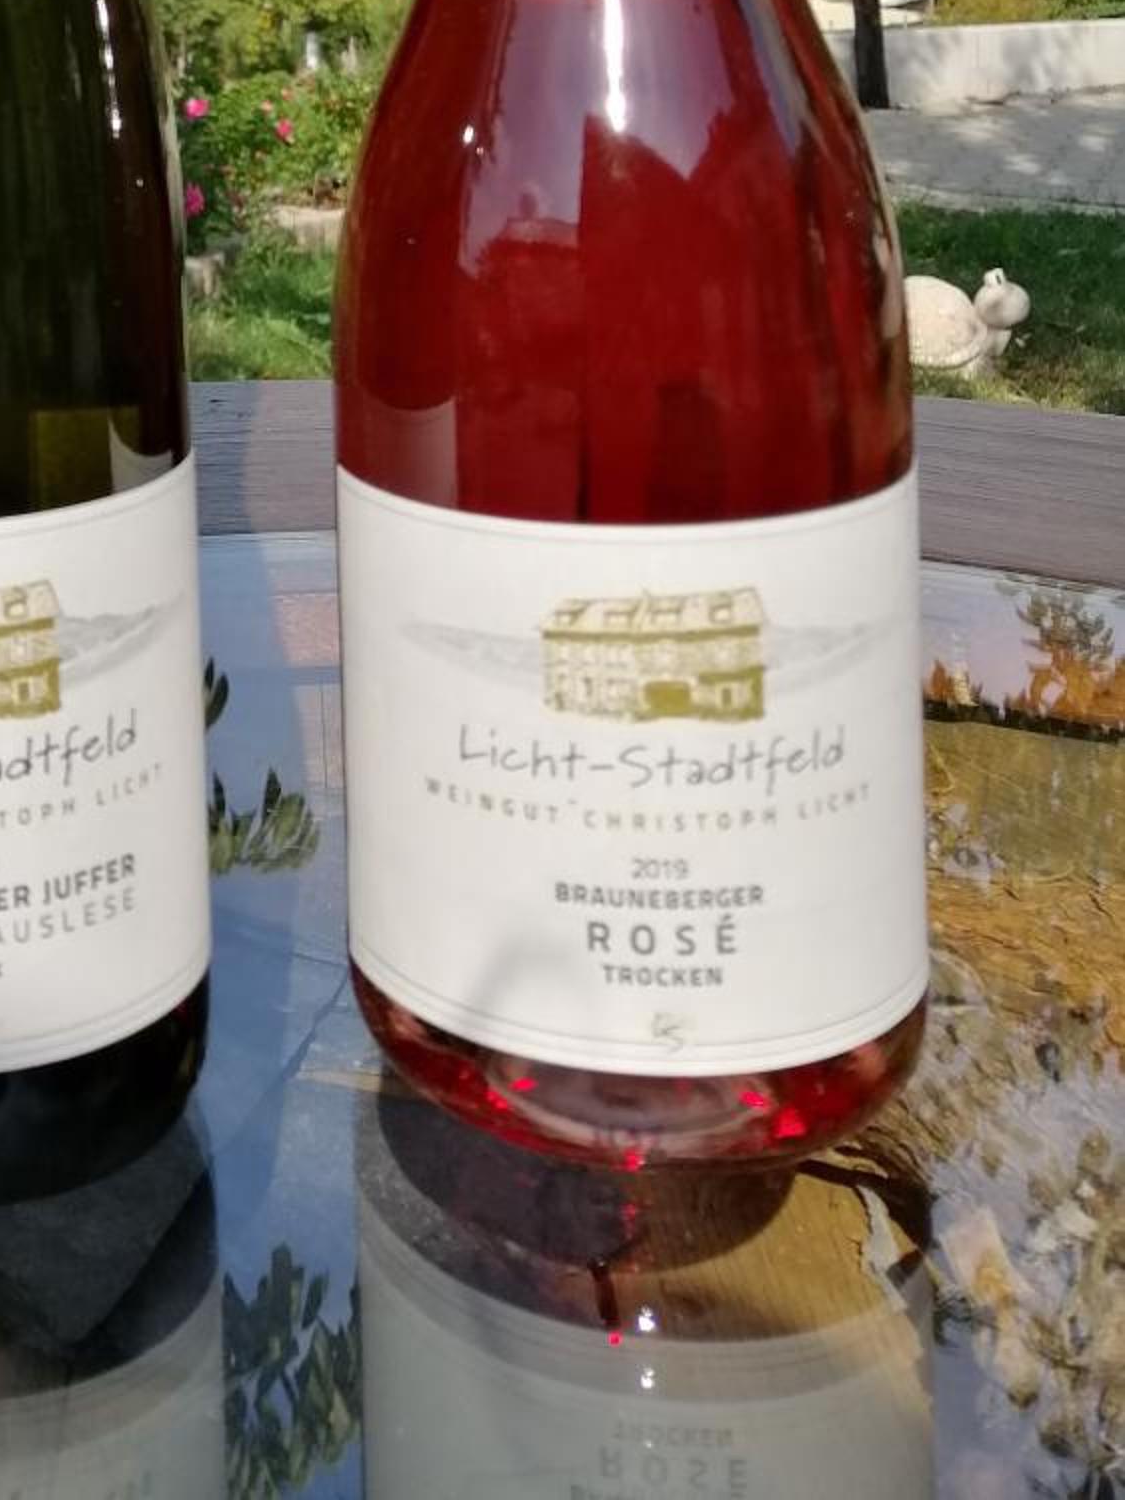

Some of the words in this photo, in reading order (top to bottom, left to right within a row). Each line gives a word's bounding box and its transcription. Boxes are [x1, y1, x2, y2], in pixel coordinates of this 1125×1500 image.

[458, 723, 846, 796] Licht-Stadtfeld
[94, 763, 163, 808] LICHT
[424, 776, 559, 824] WEINGUT
[583, 808, 776, 833] CHRISTOPH
[797, 783, 871, 821] LICHT
[42, 853, 137, 906] JUFFER
[630, 857, 690, 880] 2019
[554, 881, 764, 911] BRAUNEBERGER
[587, 914, 739, 957] ROSÉ
[601, 964, 724, 988] TROCKEN
